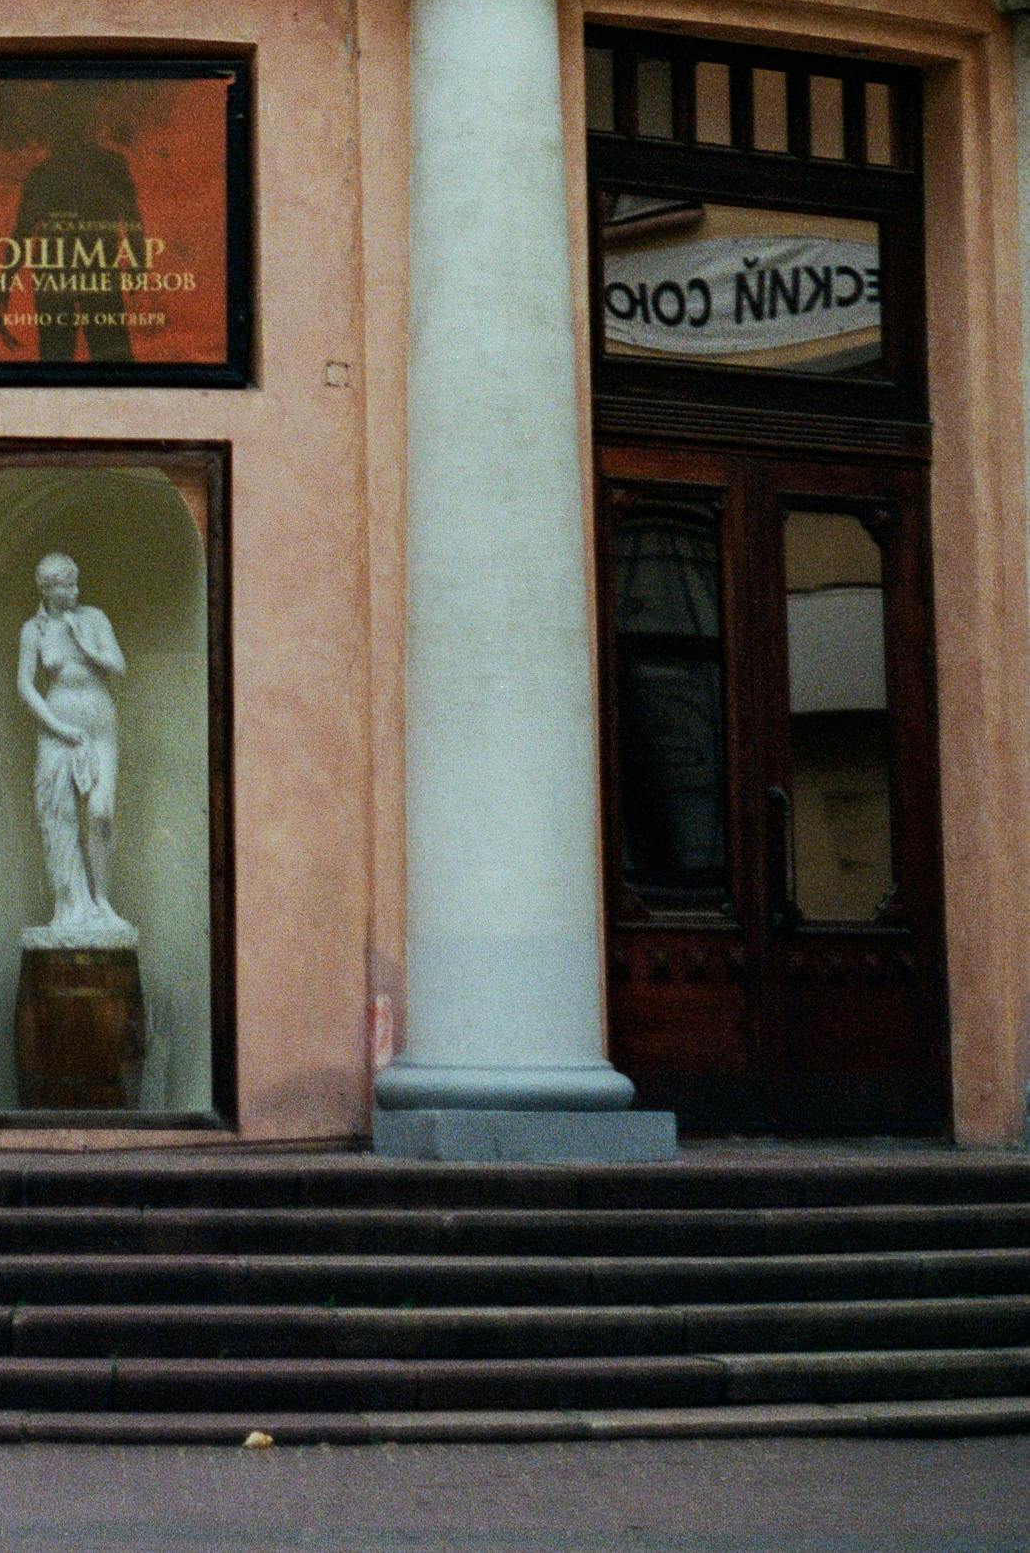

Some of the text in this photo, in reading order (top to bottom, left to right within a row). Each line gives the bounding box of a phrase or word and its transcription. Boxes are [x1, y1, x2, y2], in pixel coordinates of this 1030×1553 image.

[32, 273, 113, 293] УЛИЦЕ
[120, 272, 197, 292] ВЯЗОВ
[4, 313, 52, 326] КИНО
[57, 313, 69, 326] С
[74, 312, 90, 326] 28
[94, 313, 166, 327] ОКТЯБРЯ
